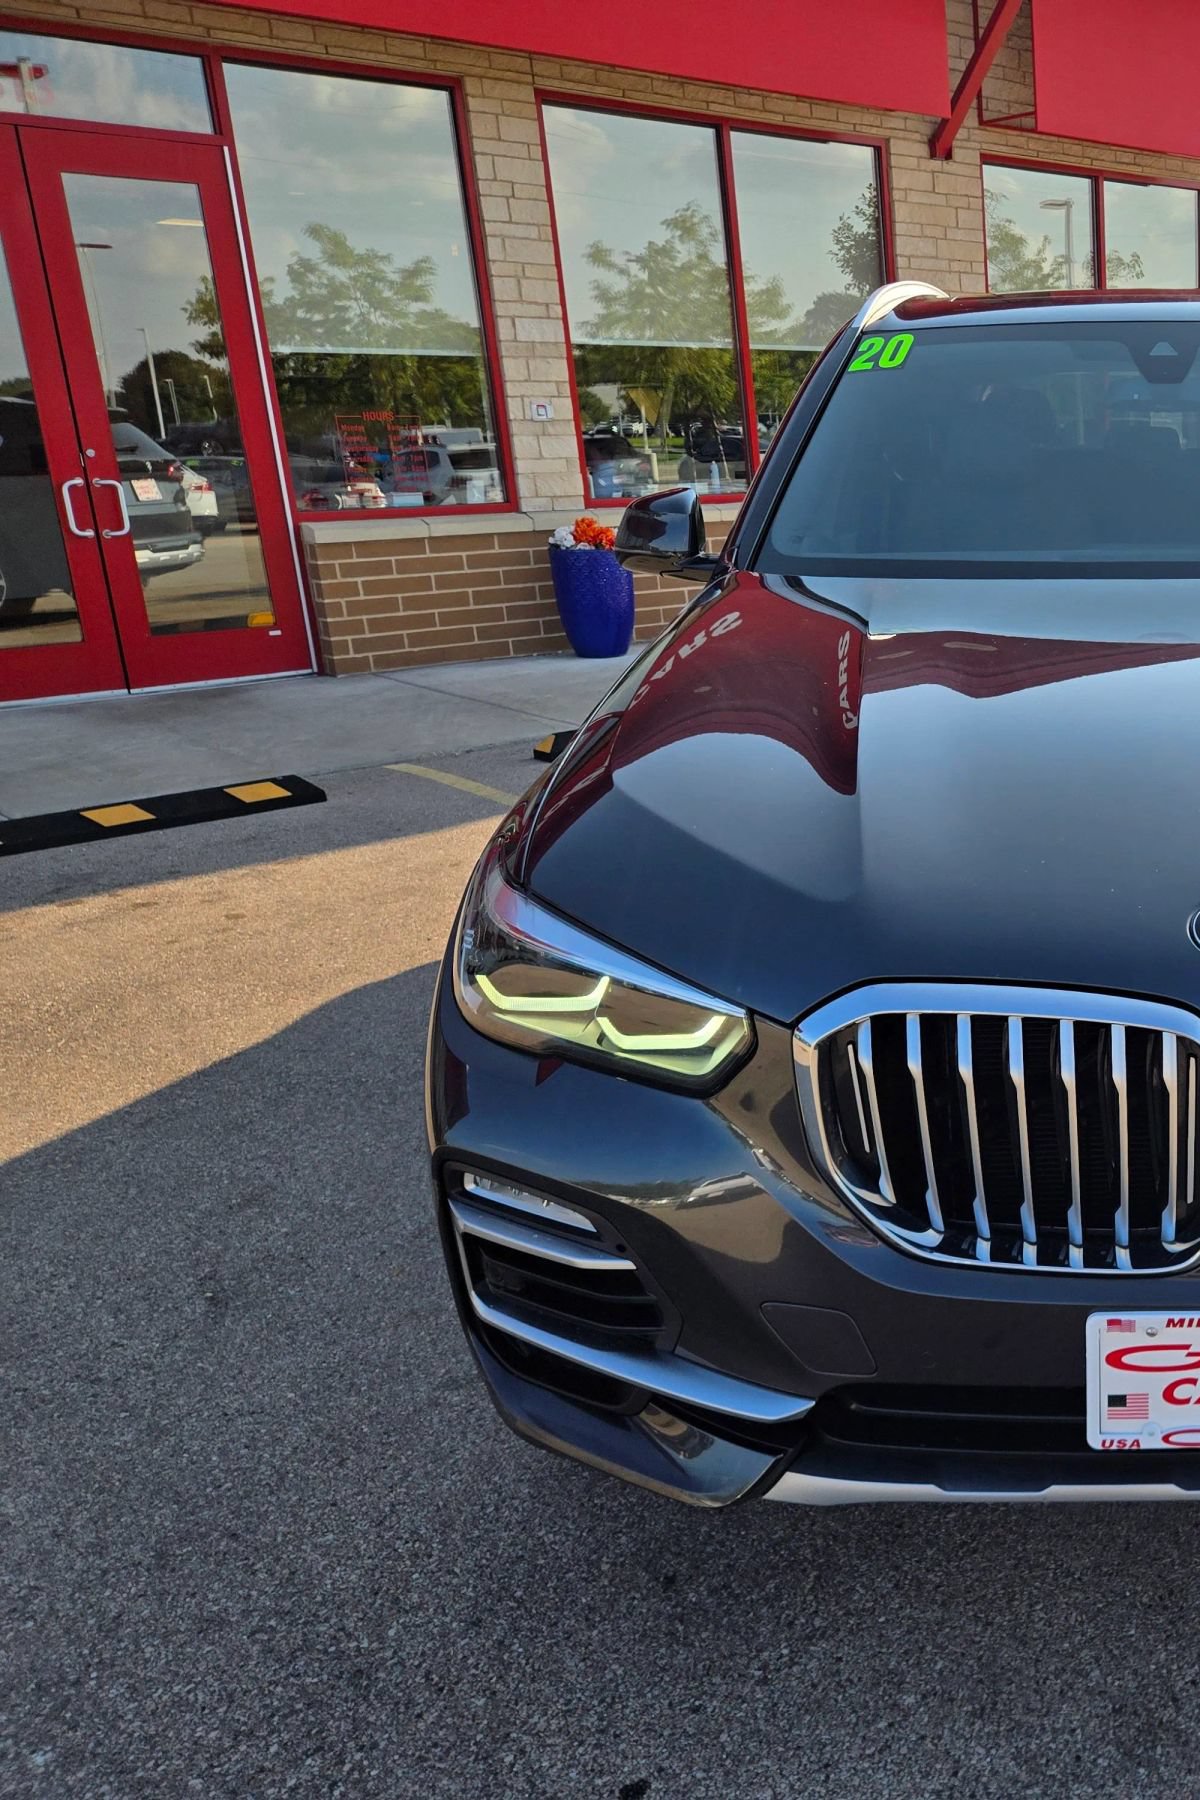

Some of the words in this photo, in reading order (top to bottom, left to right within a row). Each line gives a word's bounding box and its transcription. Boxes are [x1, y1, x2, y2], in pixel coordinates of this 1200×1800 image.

[848, 333, 914, 371] 20
[362, 411, 395, 421] HOURS
[1101, 1438, 1142, 1450] USA
